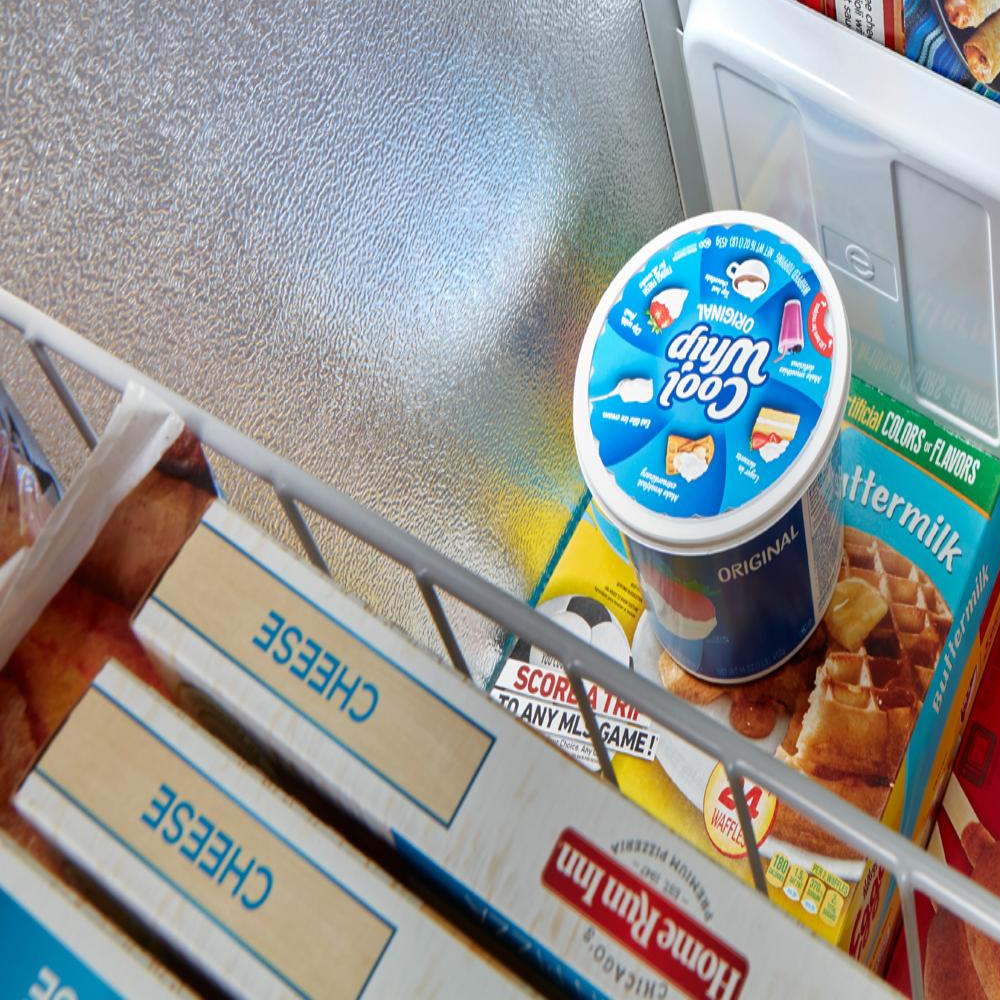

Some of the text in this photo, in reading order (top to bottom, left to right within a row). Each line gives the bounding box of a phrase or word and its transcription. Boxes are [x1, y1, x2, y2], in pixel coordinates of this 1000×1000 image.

[697, 303, 755, 334] ORIGINAL
[668, 326, 768, 385] Whip
[659, 370, 749, 420] Cool
[639, 466, 677, 489] extraordinary
[882, 411, 927, 454] COLORS
[929, 438, 981, 486] FLAVORS
[635, 478, 664, 497] breakfast
[717, 525, 800, 584] ORIGINAL
[251, 611, 379, 725] CHEESE
[932, 565, 990, 716] Buttermilk
[520, 703, 557, 728] ANY
[140, 784, 274, 911] CHEESE
[771, 853, 790, 873] 180
[610, 838, 714, 923] PREMIUM PIZZERIA
[556, 841, 742, 1000] Home Run Inn
[582, 925, 668, 1000] CHICAGO'S
